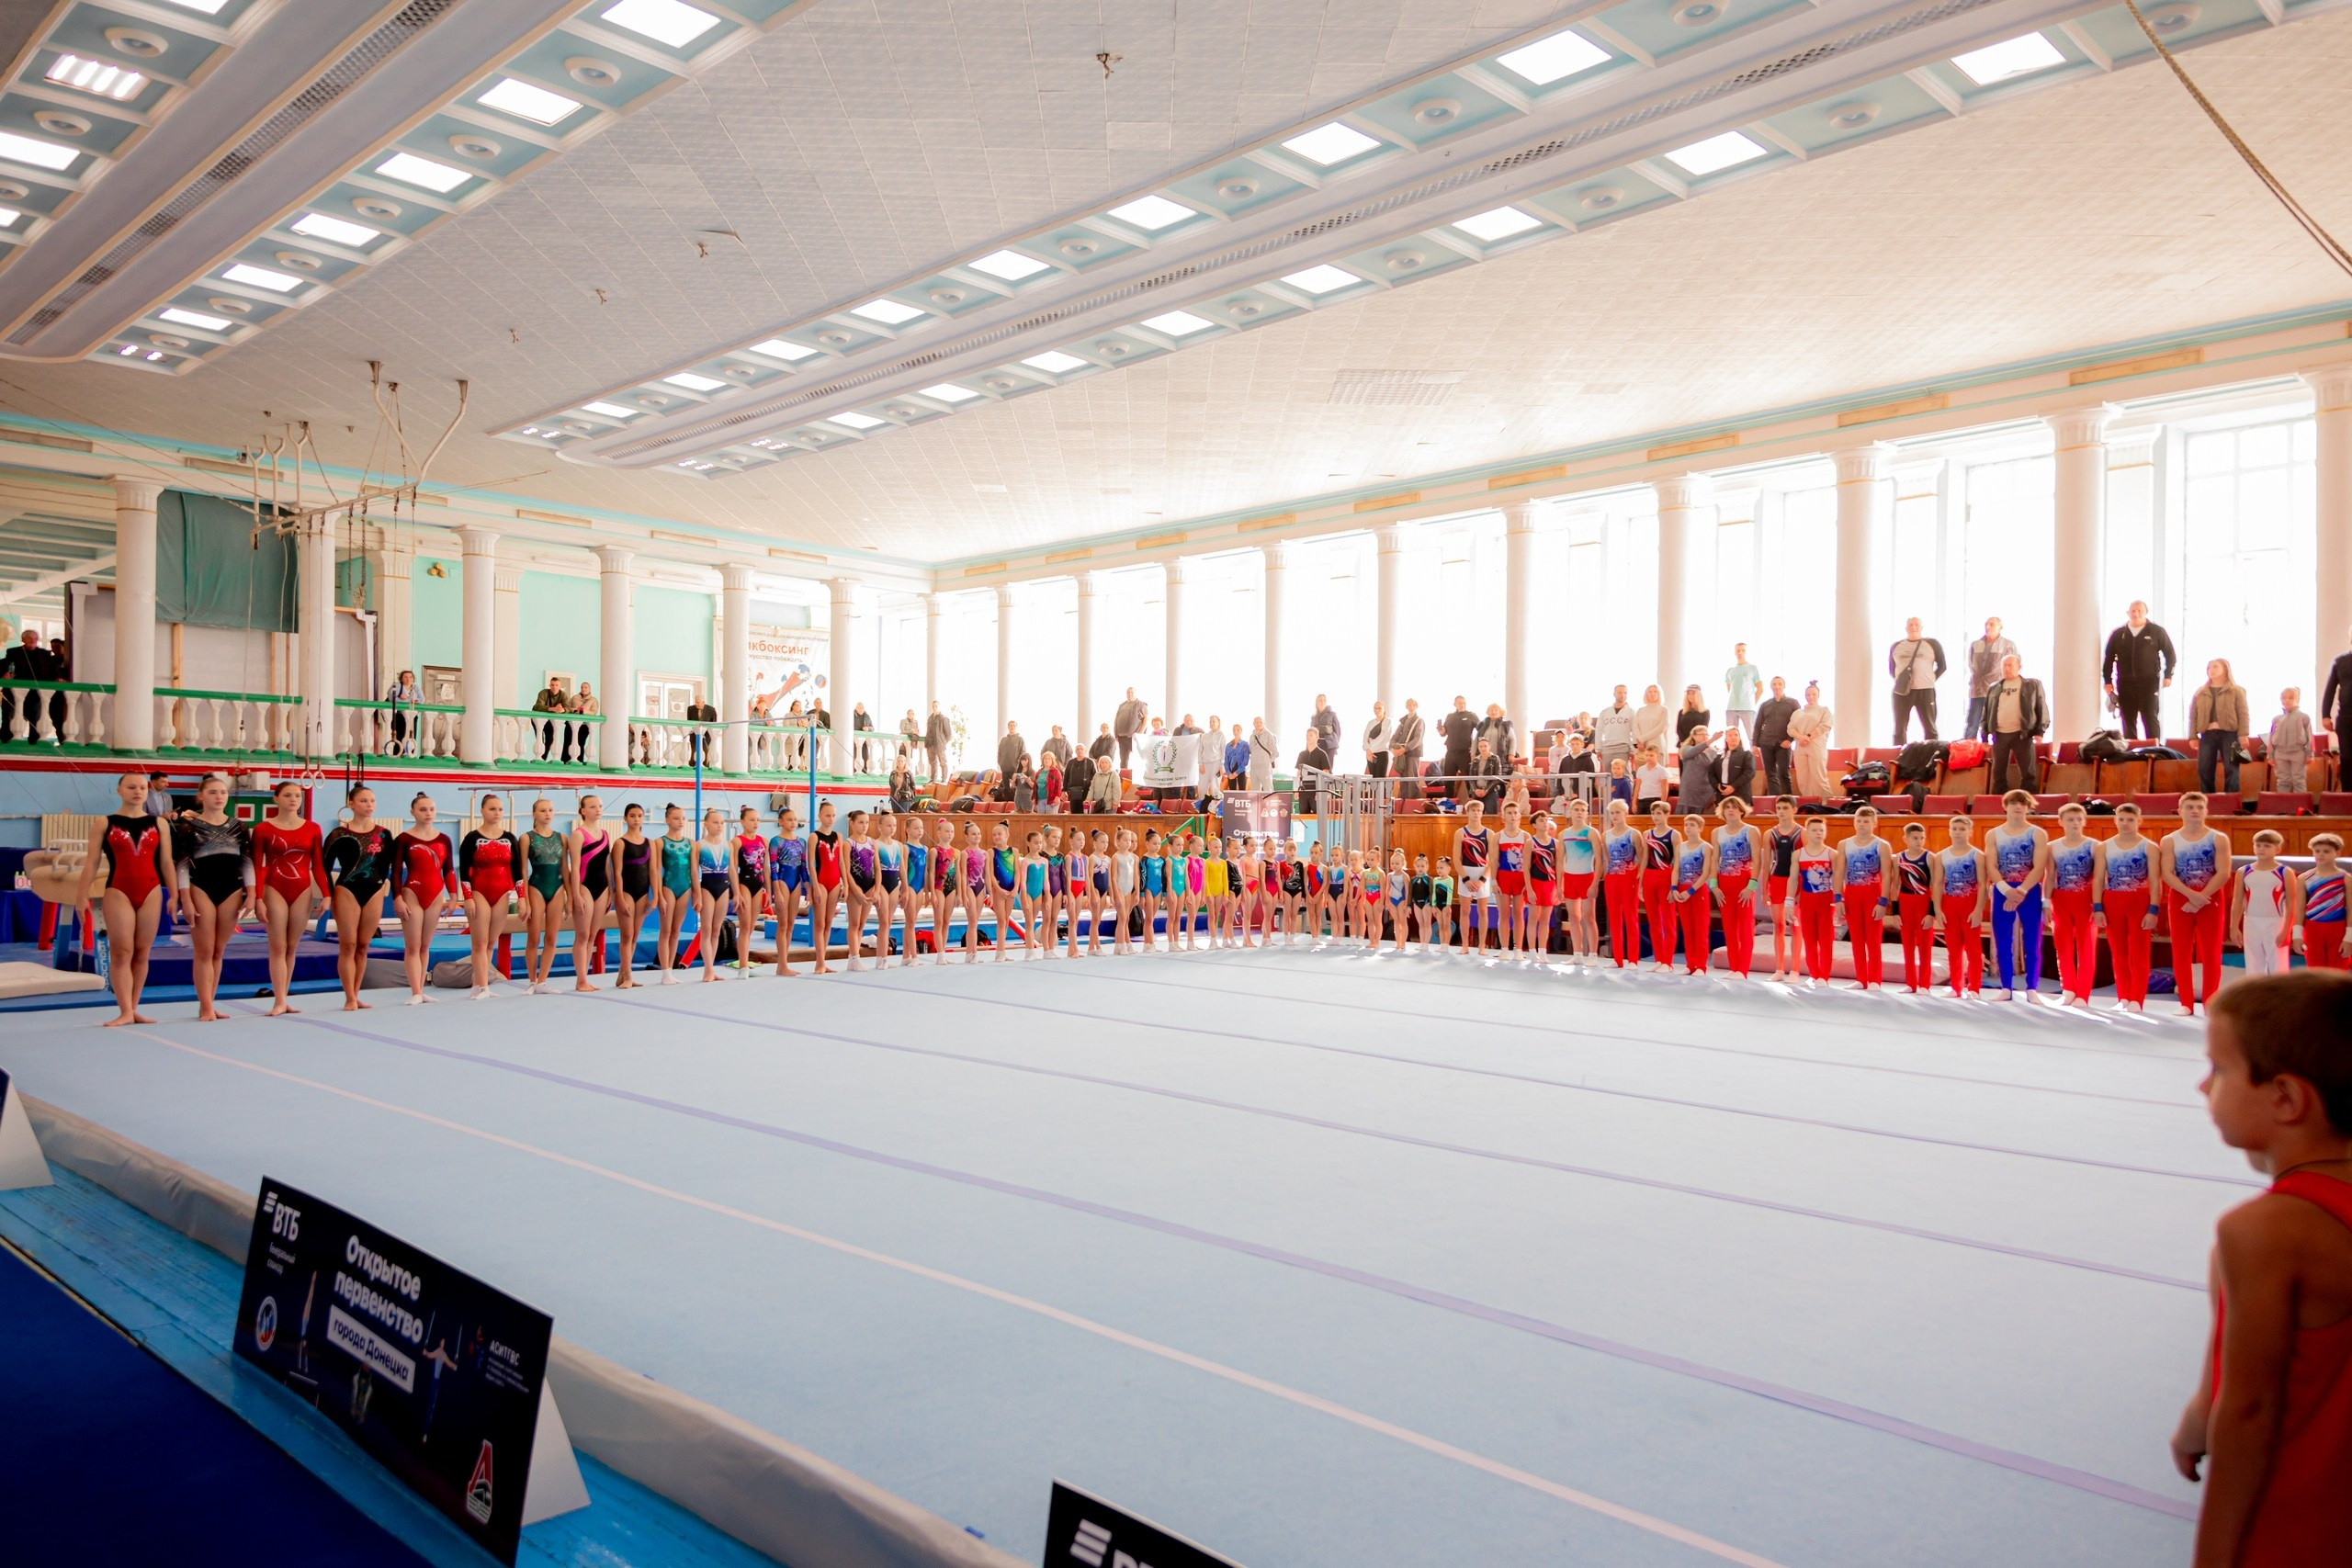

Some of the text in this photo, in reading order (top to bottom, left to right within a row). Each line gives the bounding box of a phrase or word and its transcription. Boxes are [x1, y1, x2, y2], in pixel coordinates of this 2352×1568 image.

[1235, 799, 1251, 807] ВТБ
[273, 1201, 301, 1242] ВТБ
[345, 1235, 422, 1302] Открытое
[334, 1270, 424, 1344] первенство
[334, 1317, 410, 1381] города Донецка
